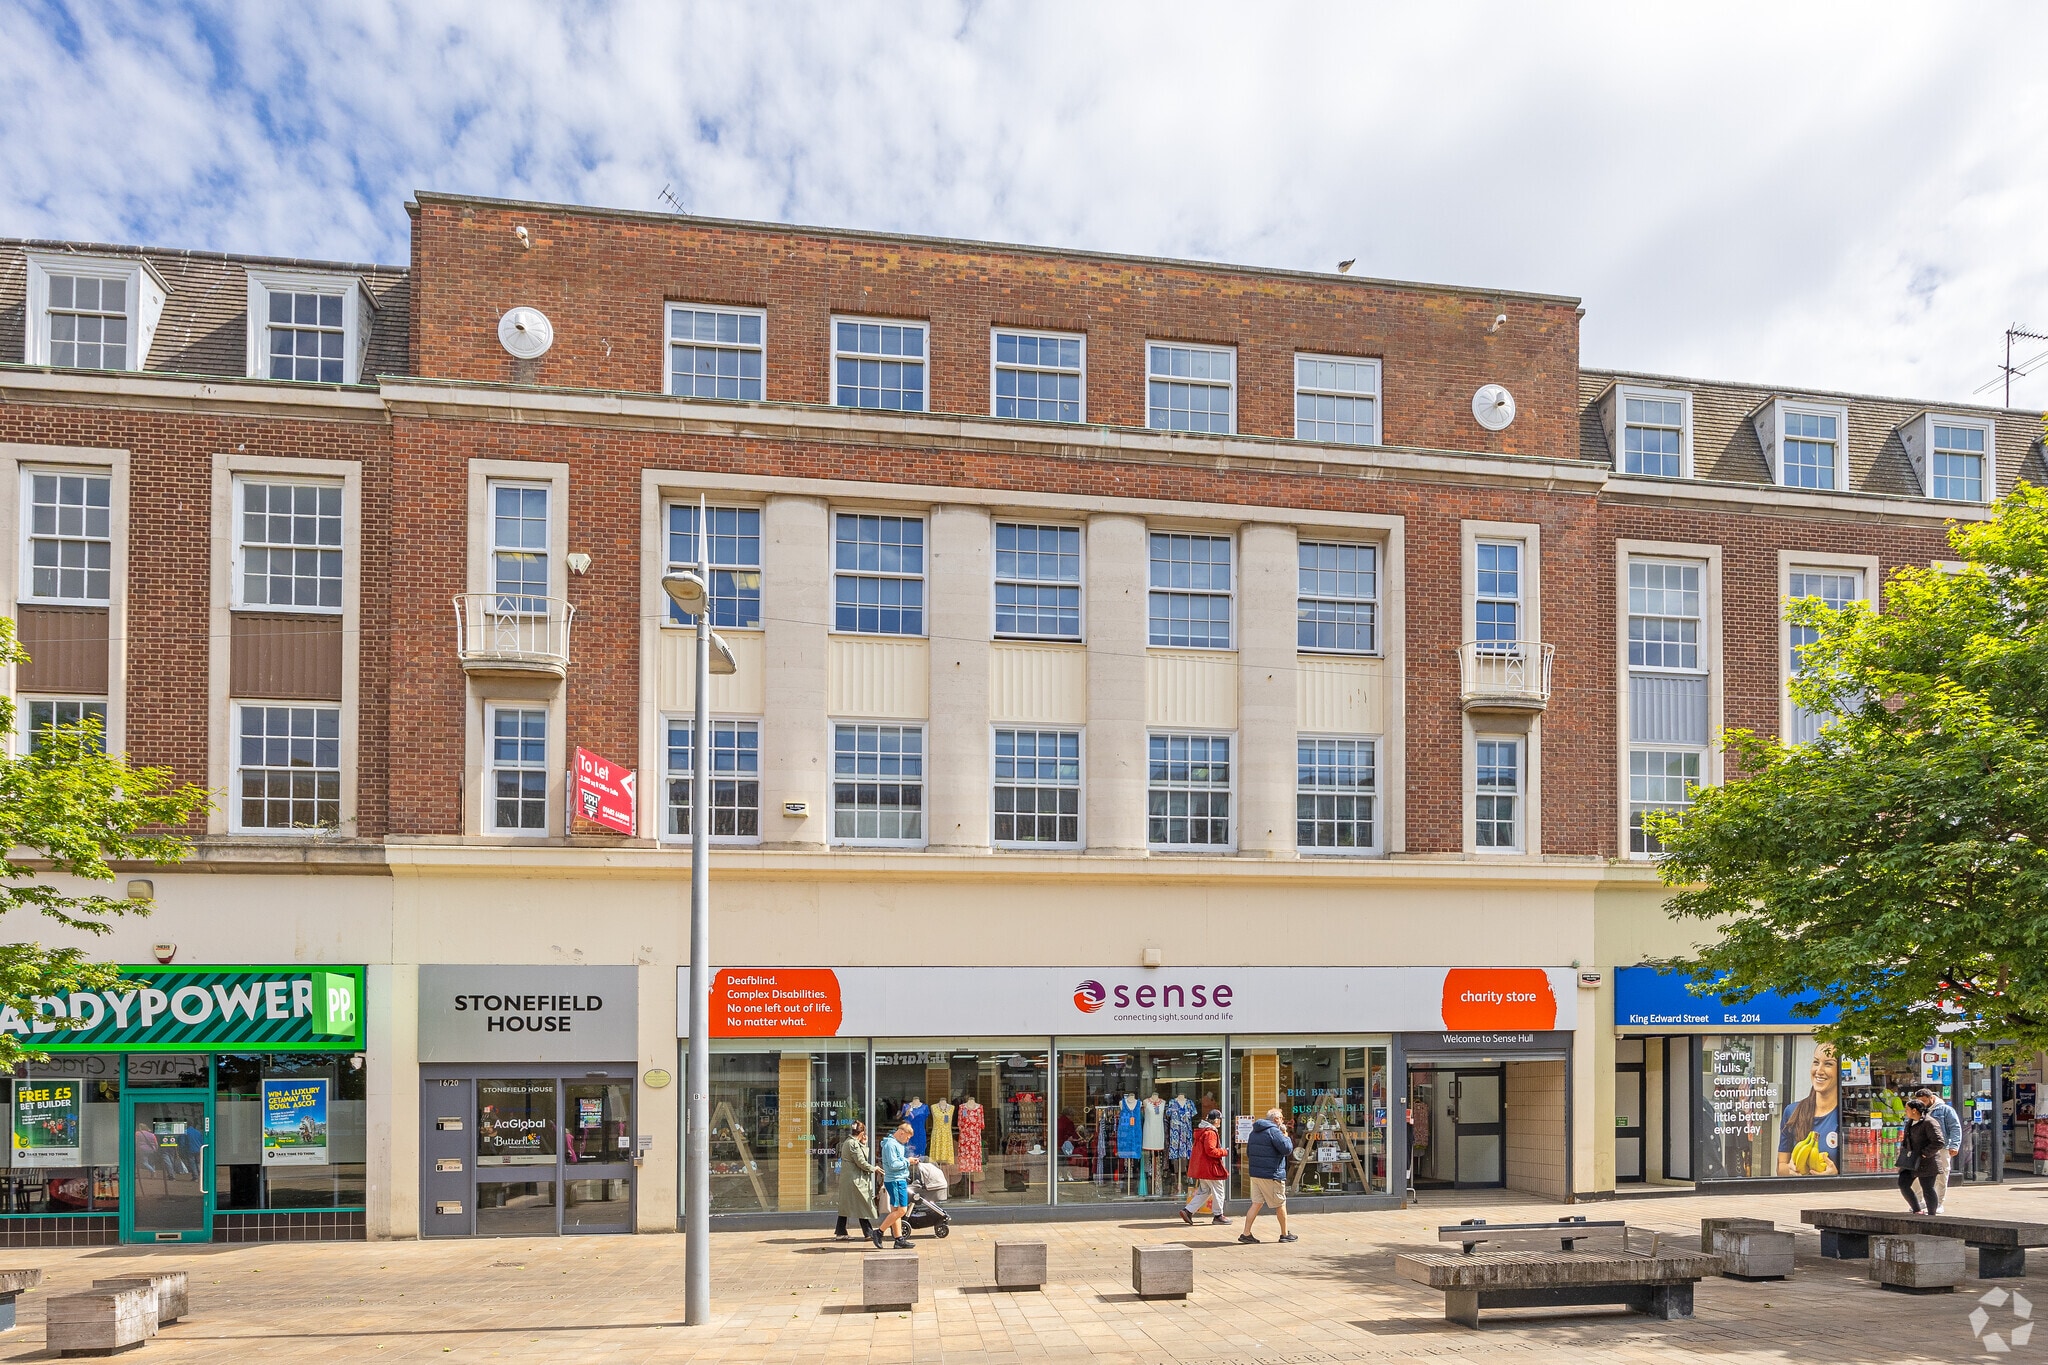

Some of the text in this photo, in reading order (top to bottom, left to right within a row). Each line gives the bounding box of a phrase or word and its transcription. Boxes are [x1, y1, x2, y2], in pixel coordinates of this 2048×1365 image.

[580, 754, 592, 773] To
[594, 761, 609, 781] Let
[583, 793, 599, 807] PPH
[727, 976, 778, 985] Deafblind.
[727, 989, 827, 999] Complex Disabilities.
[1114, 984, 1233, 1008] sense
[1460, 990, 1537, 1005] charity store
[454, 995, 603, 1012] STONEFIELD
[727, 1003, 833, 1013] No one left out of life.
[727, 1017, 807, 1026] No matter what.
[1114, 1012, 1234, 1022] connecting sight, sound and life
[1629, 1014, 1760, 1024] King Edward Street Est. 2014
[487, 1016, 571, 1032] HOUSE
[1443, 1034, 1534, 1043] Welcome to Sense Hull
[1714, 1051, 1751, 1062] Serving
[1714, 1077, 1769, 1085] customers,
[19, 1087, 72, 1102] FREE £5
[291, 1087, 320, 1095] LUXURY
[1287, 1088, 1353, 1097] BIG BRANDS
[1714, 1087, 1777, 1098] communities
[20, 1099, 71, 1110] BET BUILDER
[268, 1095, 300, 1104] GETAWAY
[293, 1100, 316, 1108] ASCOT
[1714, 1100, 1733, 1110] and
[1735, 1100, 1766, 1111] planet
[1714, 1112, 1769, 1122] little better
[494, 1119, 546, 1132] AaGlobal
[1714, 1126, 1742, 1136] every
